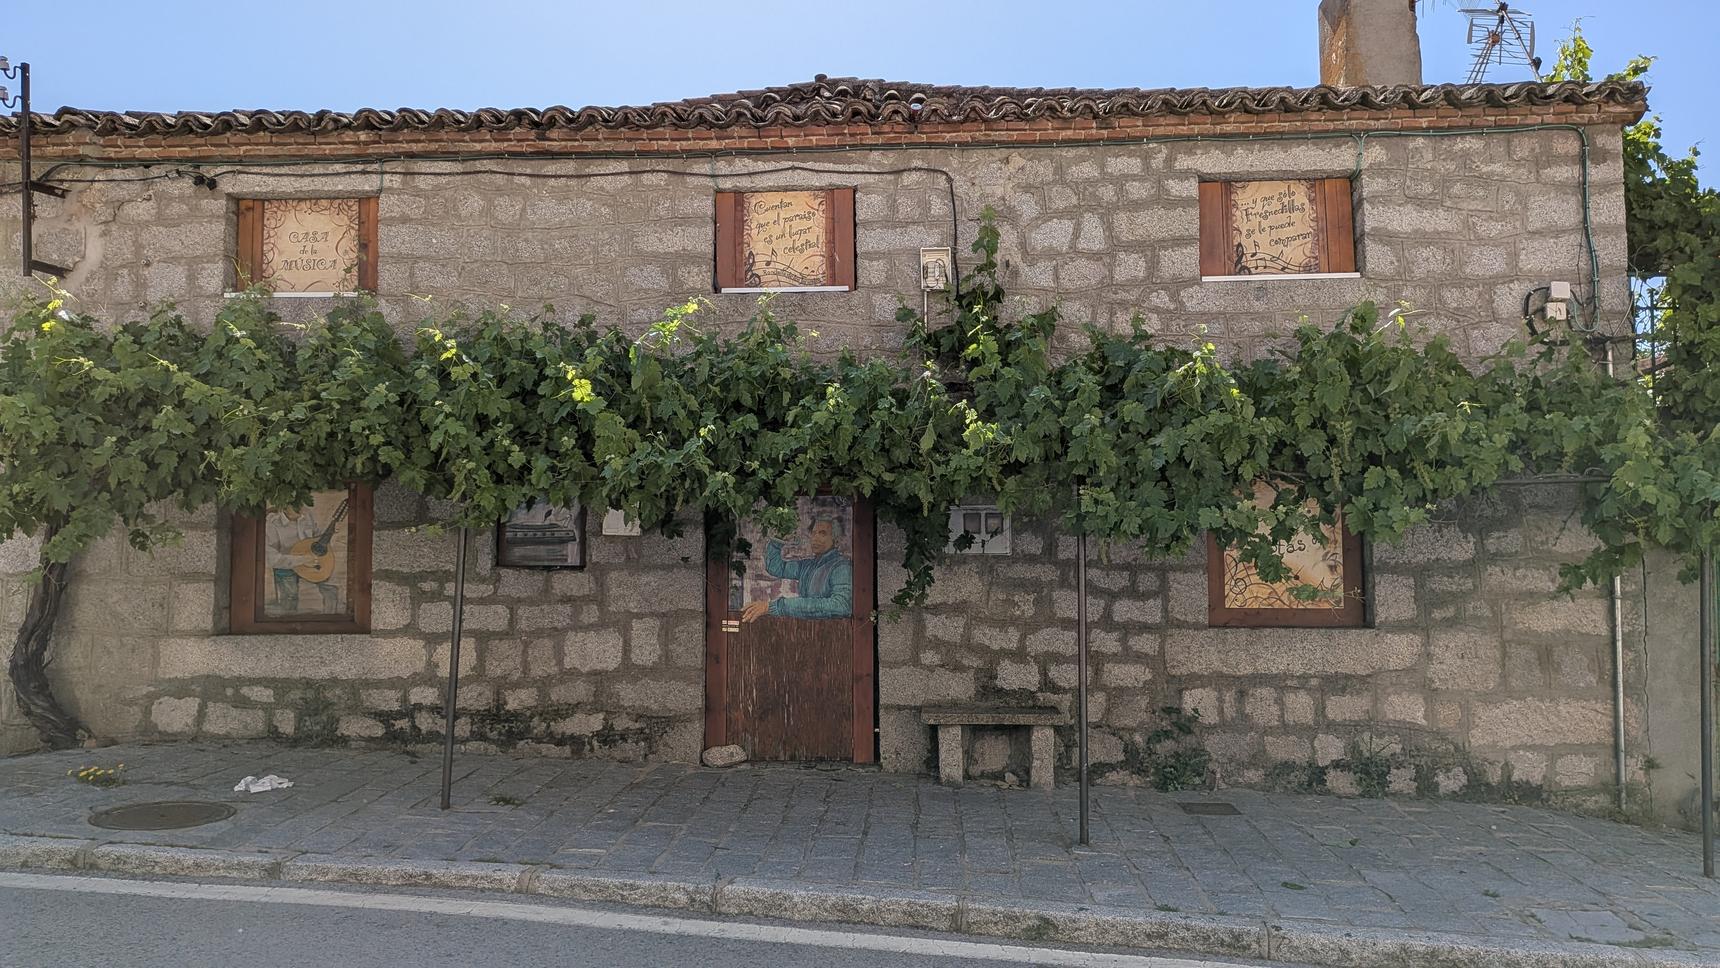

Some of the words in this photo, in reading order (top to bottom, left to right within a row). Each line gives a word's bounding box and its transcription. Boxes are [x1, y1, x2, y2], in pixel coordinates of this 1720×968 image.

[754, 198, 793, 215] Cuentan
[1242, 199, 1306, 223] Fresnedillas
[1260, 195, 1275, 210] que
[755, 221, 770, 236] que
[773, 212, 780, 225] el
[1245, 228, 1255, 239] se
[1258, 220, 1266, 235] le
[1268, 216, 1296, 236] puede
[289, 231, 329, 243] CASA
[763, 234, 774, 245] es
[775, 233, 786, 241] un
[788, 224, 813, 241] lugar
[783, 234, 820, 254] celestial
[299, 245, 309, 255] de
[310, 245, 318, 255] la
